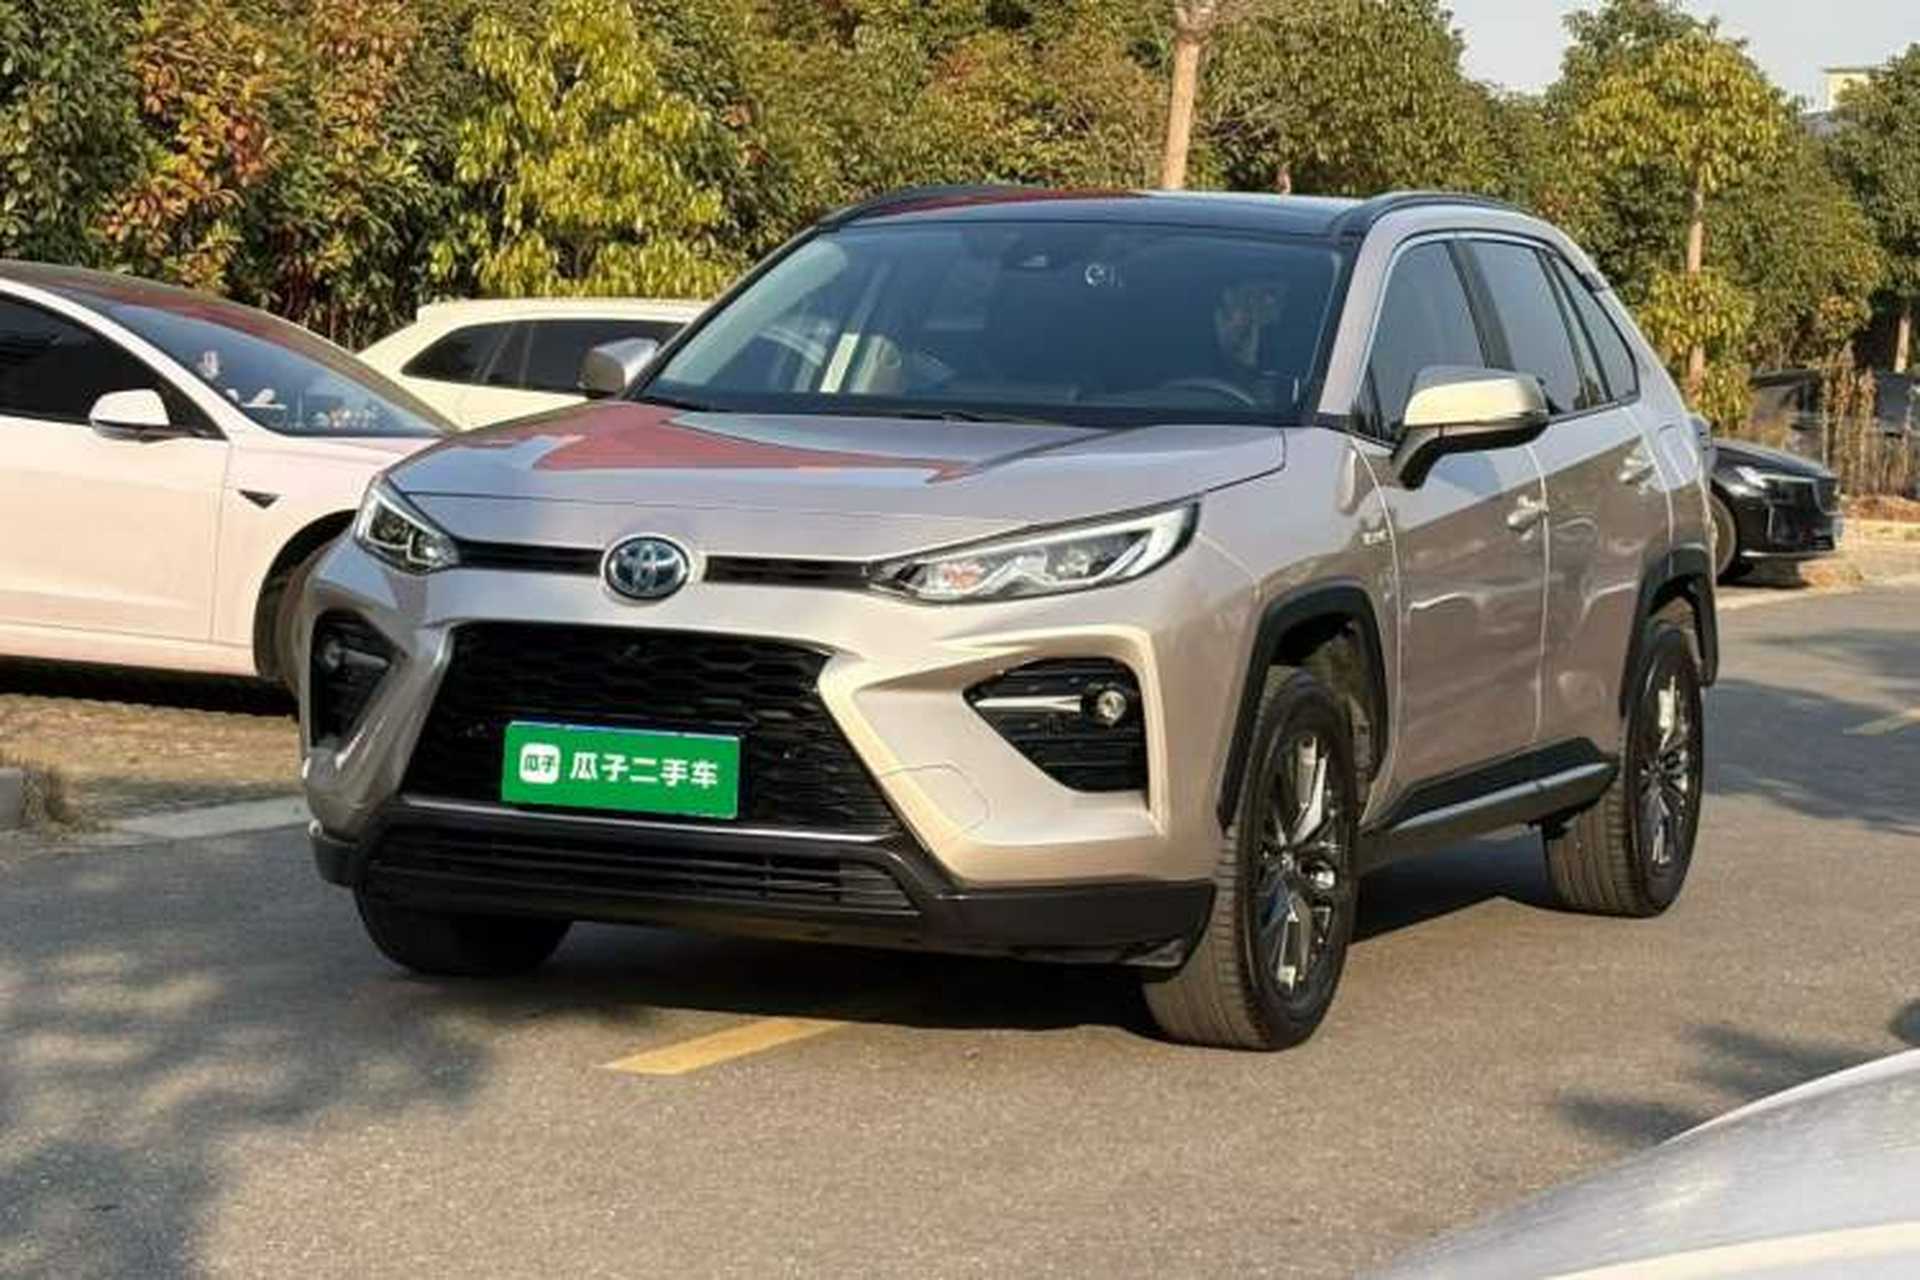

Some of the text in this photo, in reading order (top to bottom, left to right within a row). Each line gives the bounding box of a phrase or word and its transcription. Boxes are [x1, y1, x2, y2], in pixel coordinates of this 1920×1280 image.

[524, 752, 718, 788] 瓜子 瓜子二手车
